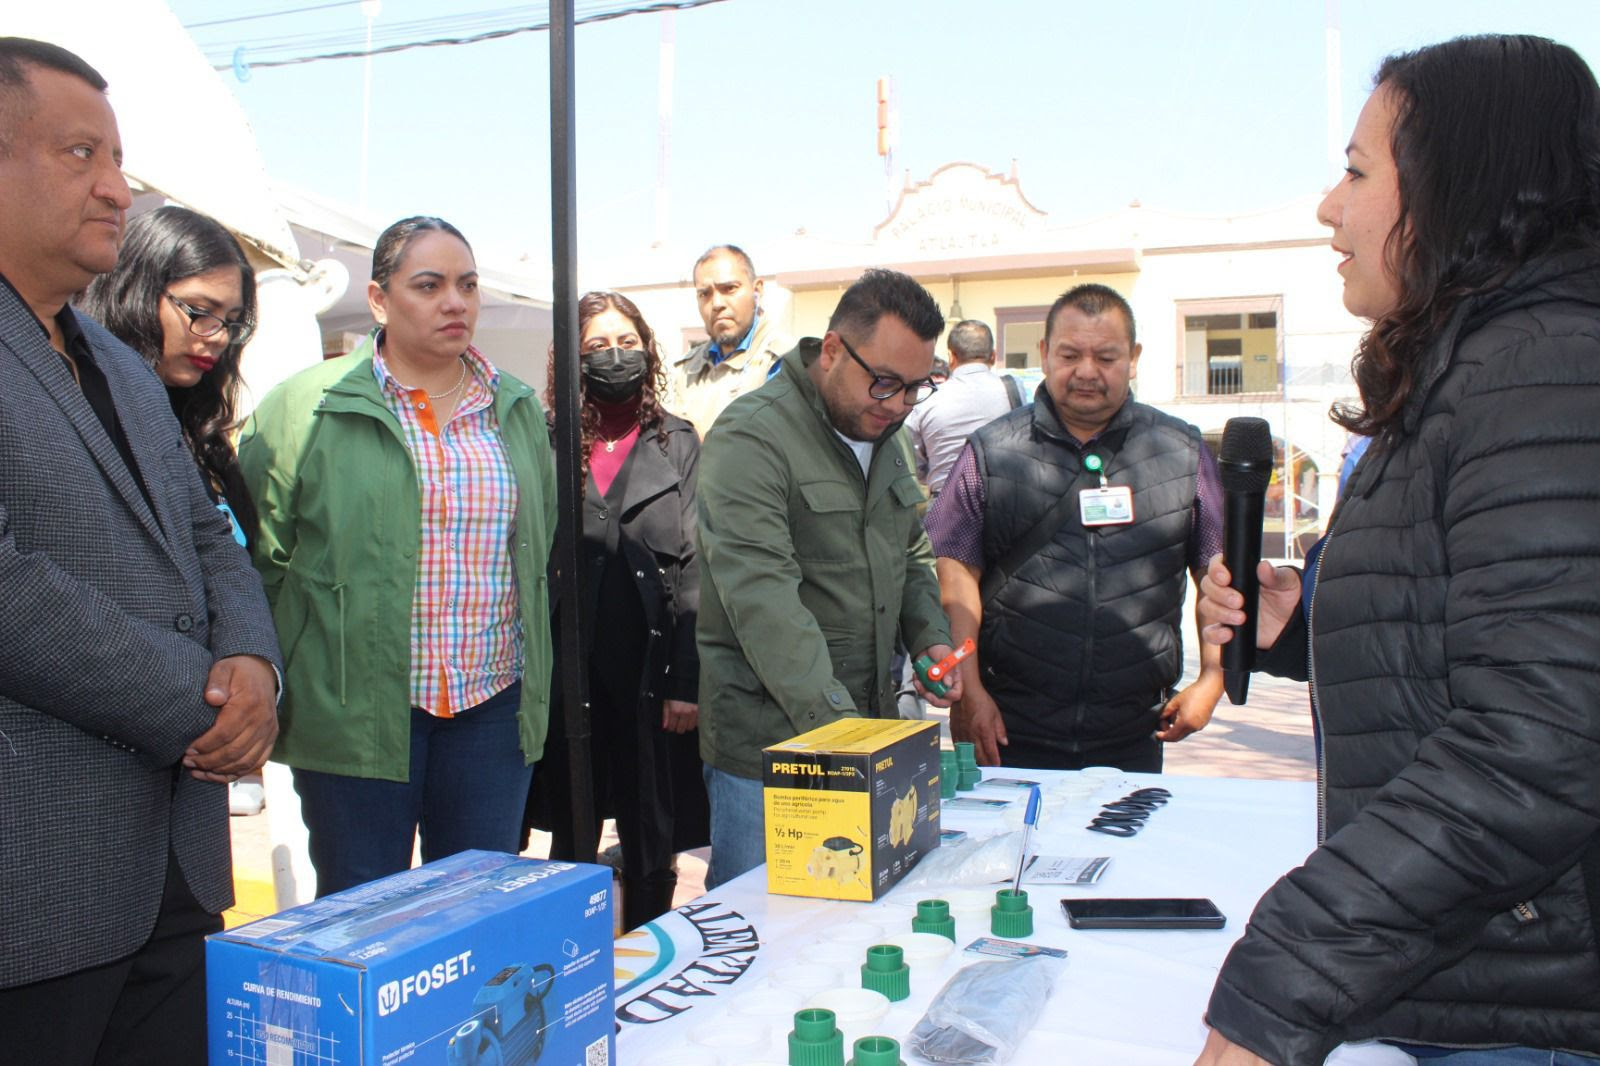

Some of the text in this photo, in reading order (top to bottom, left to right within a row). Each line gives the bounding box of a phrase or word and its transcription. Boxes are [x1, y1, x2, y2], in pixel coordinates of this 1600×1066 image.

[772, 762, 825, 776] PRETUL
[875, 756, 893, 774] PRETUL
[788, 828, 803, 841] Hp
[494, 867, 559, 893] FOSET
[243, 981, 321, 1008] CURVA DE RENDIMIENTO
[226, 1011, 233, 1020] 25
